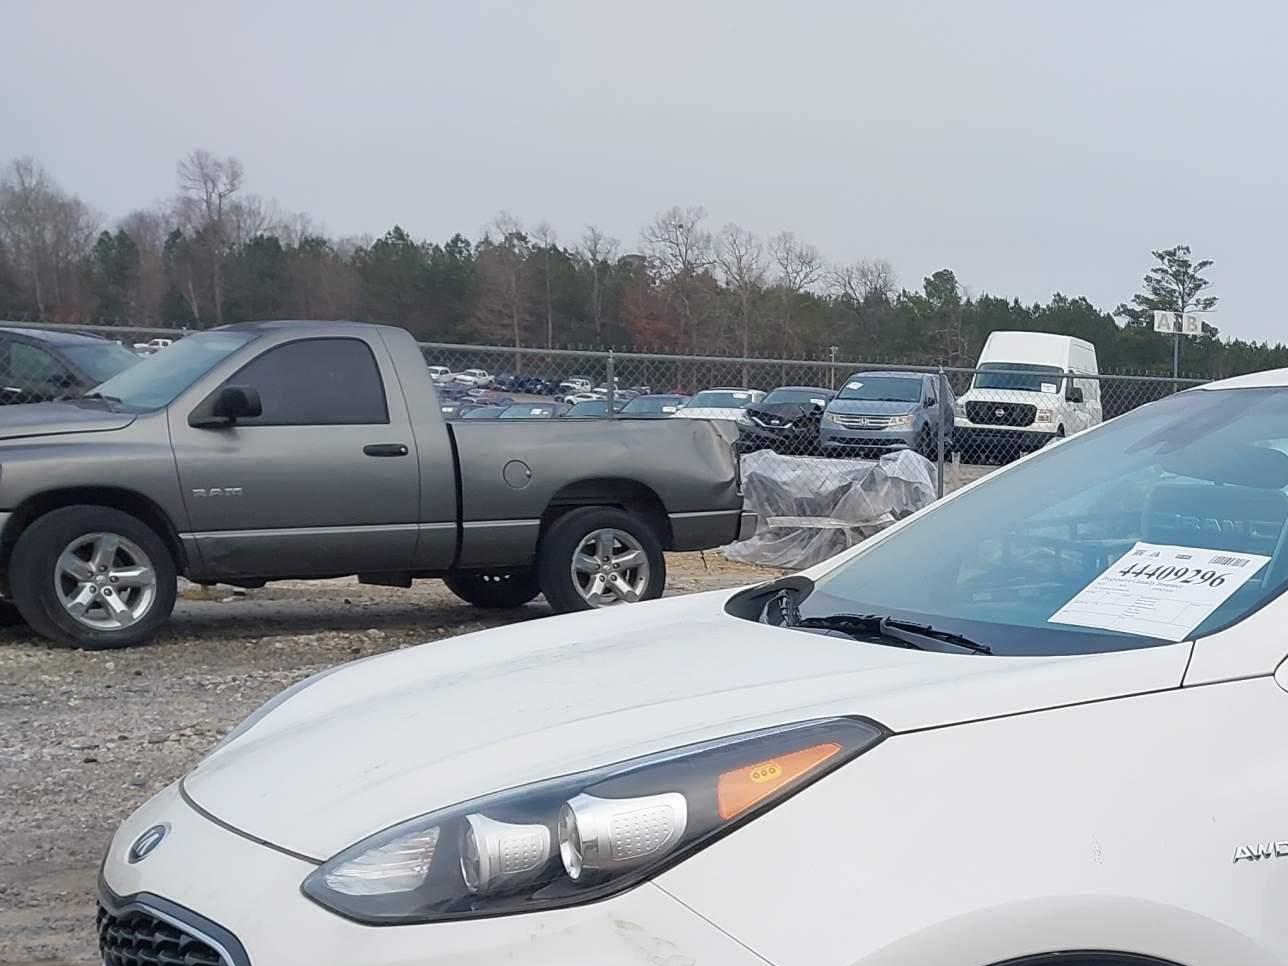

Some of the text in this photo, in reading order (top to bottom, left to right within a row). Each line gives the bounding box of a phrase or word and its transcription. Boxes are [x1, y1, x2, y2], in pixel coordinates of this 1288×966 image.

[1156, 313, 1198, 332] A B
[191, 487, 243, 497] RAM
[1118, 562, 1233, 588] 44409296
